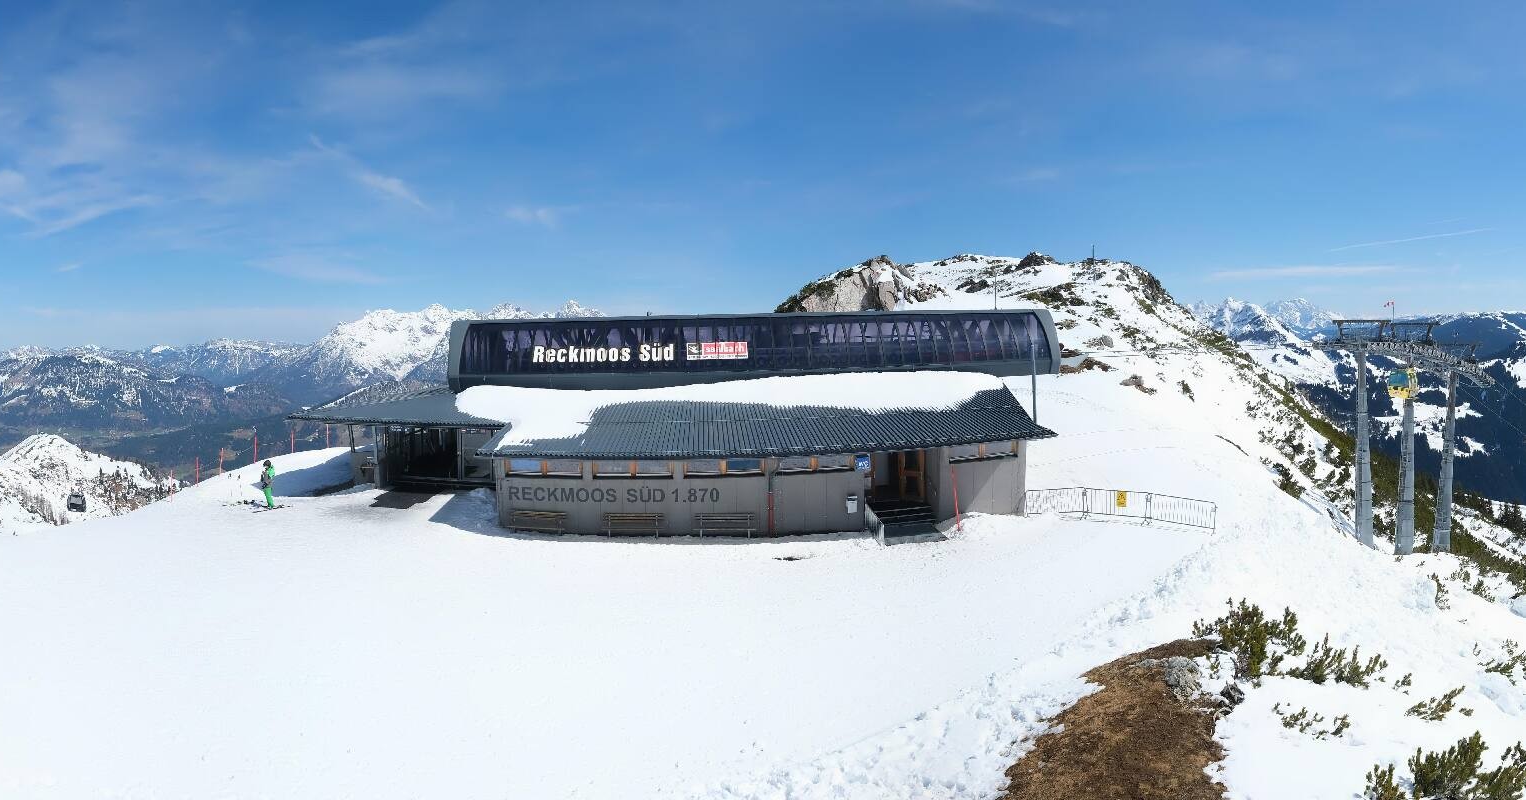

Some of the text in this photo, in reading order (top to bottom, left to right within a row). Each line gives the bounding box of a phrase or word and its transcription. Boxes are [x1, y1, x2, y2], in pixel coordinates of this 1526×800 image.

[532, 342, 675, 363] Reckmoos Süd
[508, 485, 720, 503] RECKMOOS SÜD 1.870
